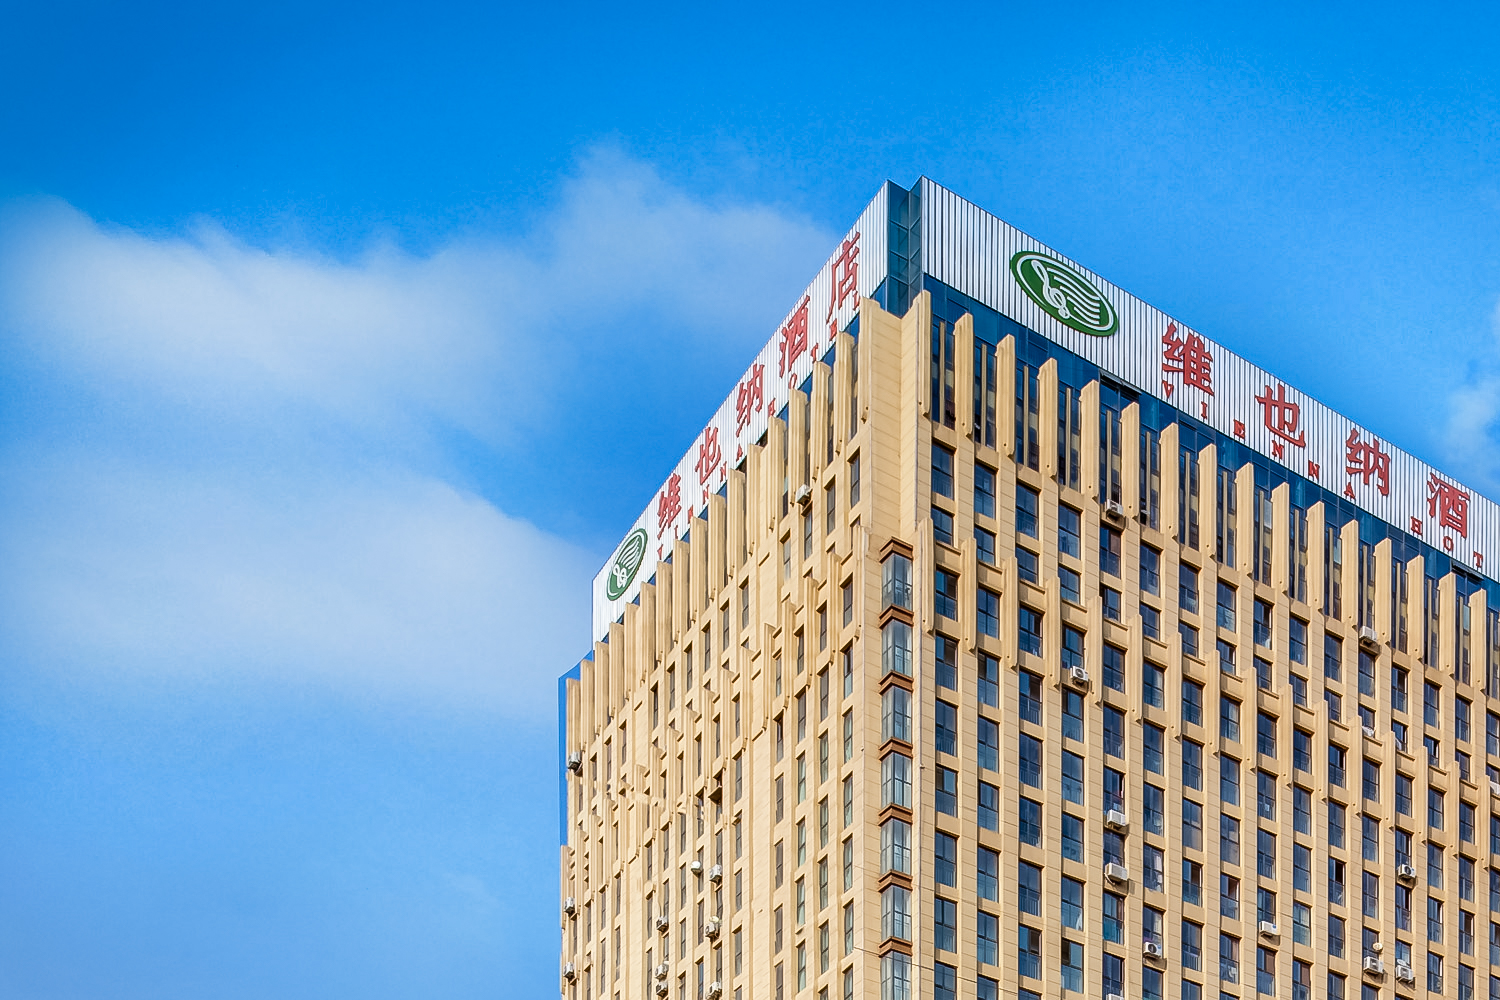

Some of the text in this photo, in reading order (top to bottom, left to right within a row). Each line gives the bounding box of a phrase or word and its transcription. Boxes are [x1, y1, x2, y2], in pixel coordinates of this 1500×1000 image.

[656, 231, 861, 540] 维也纳酒店
[1163, 380, 1356, 500] VIENNA
[656, 443, 743, 560] VIENNA
